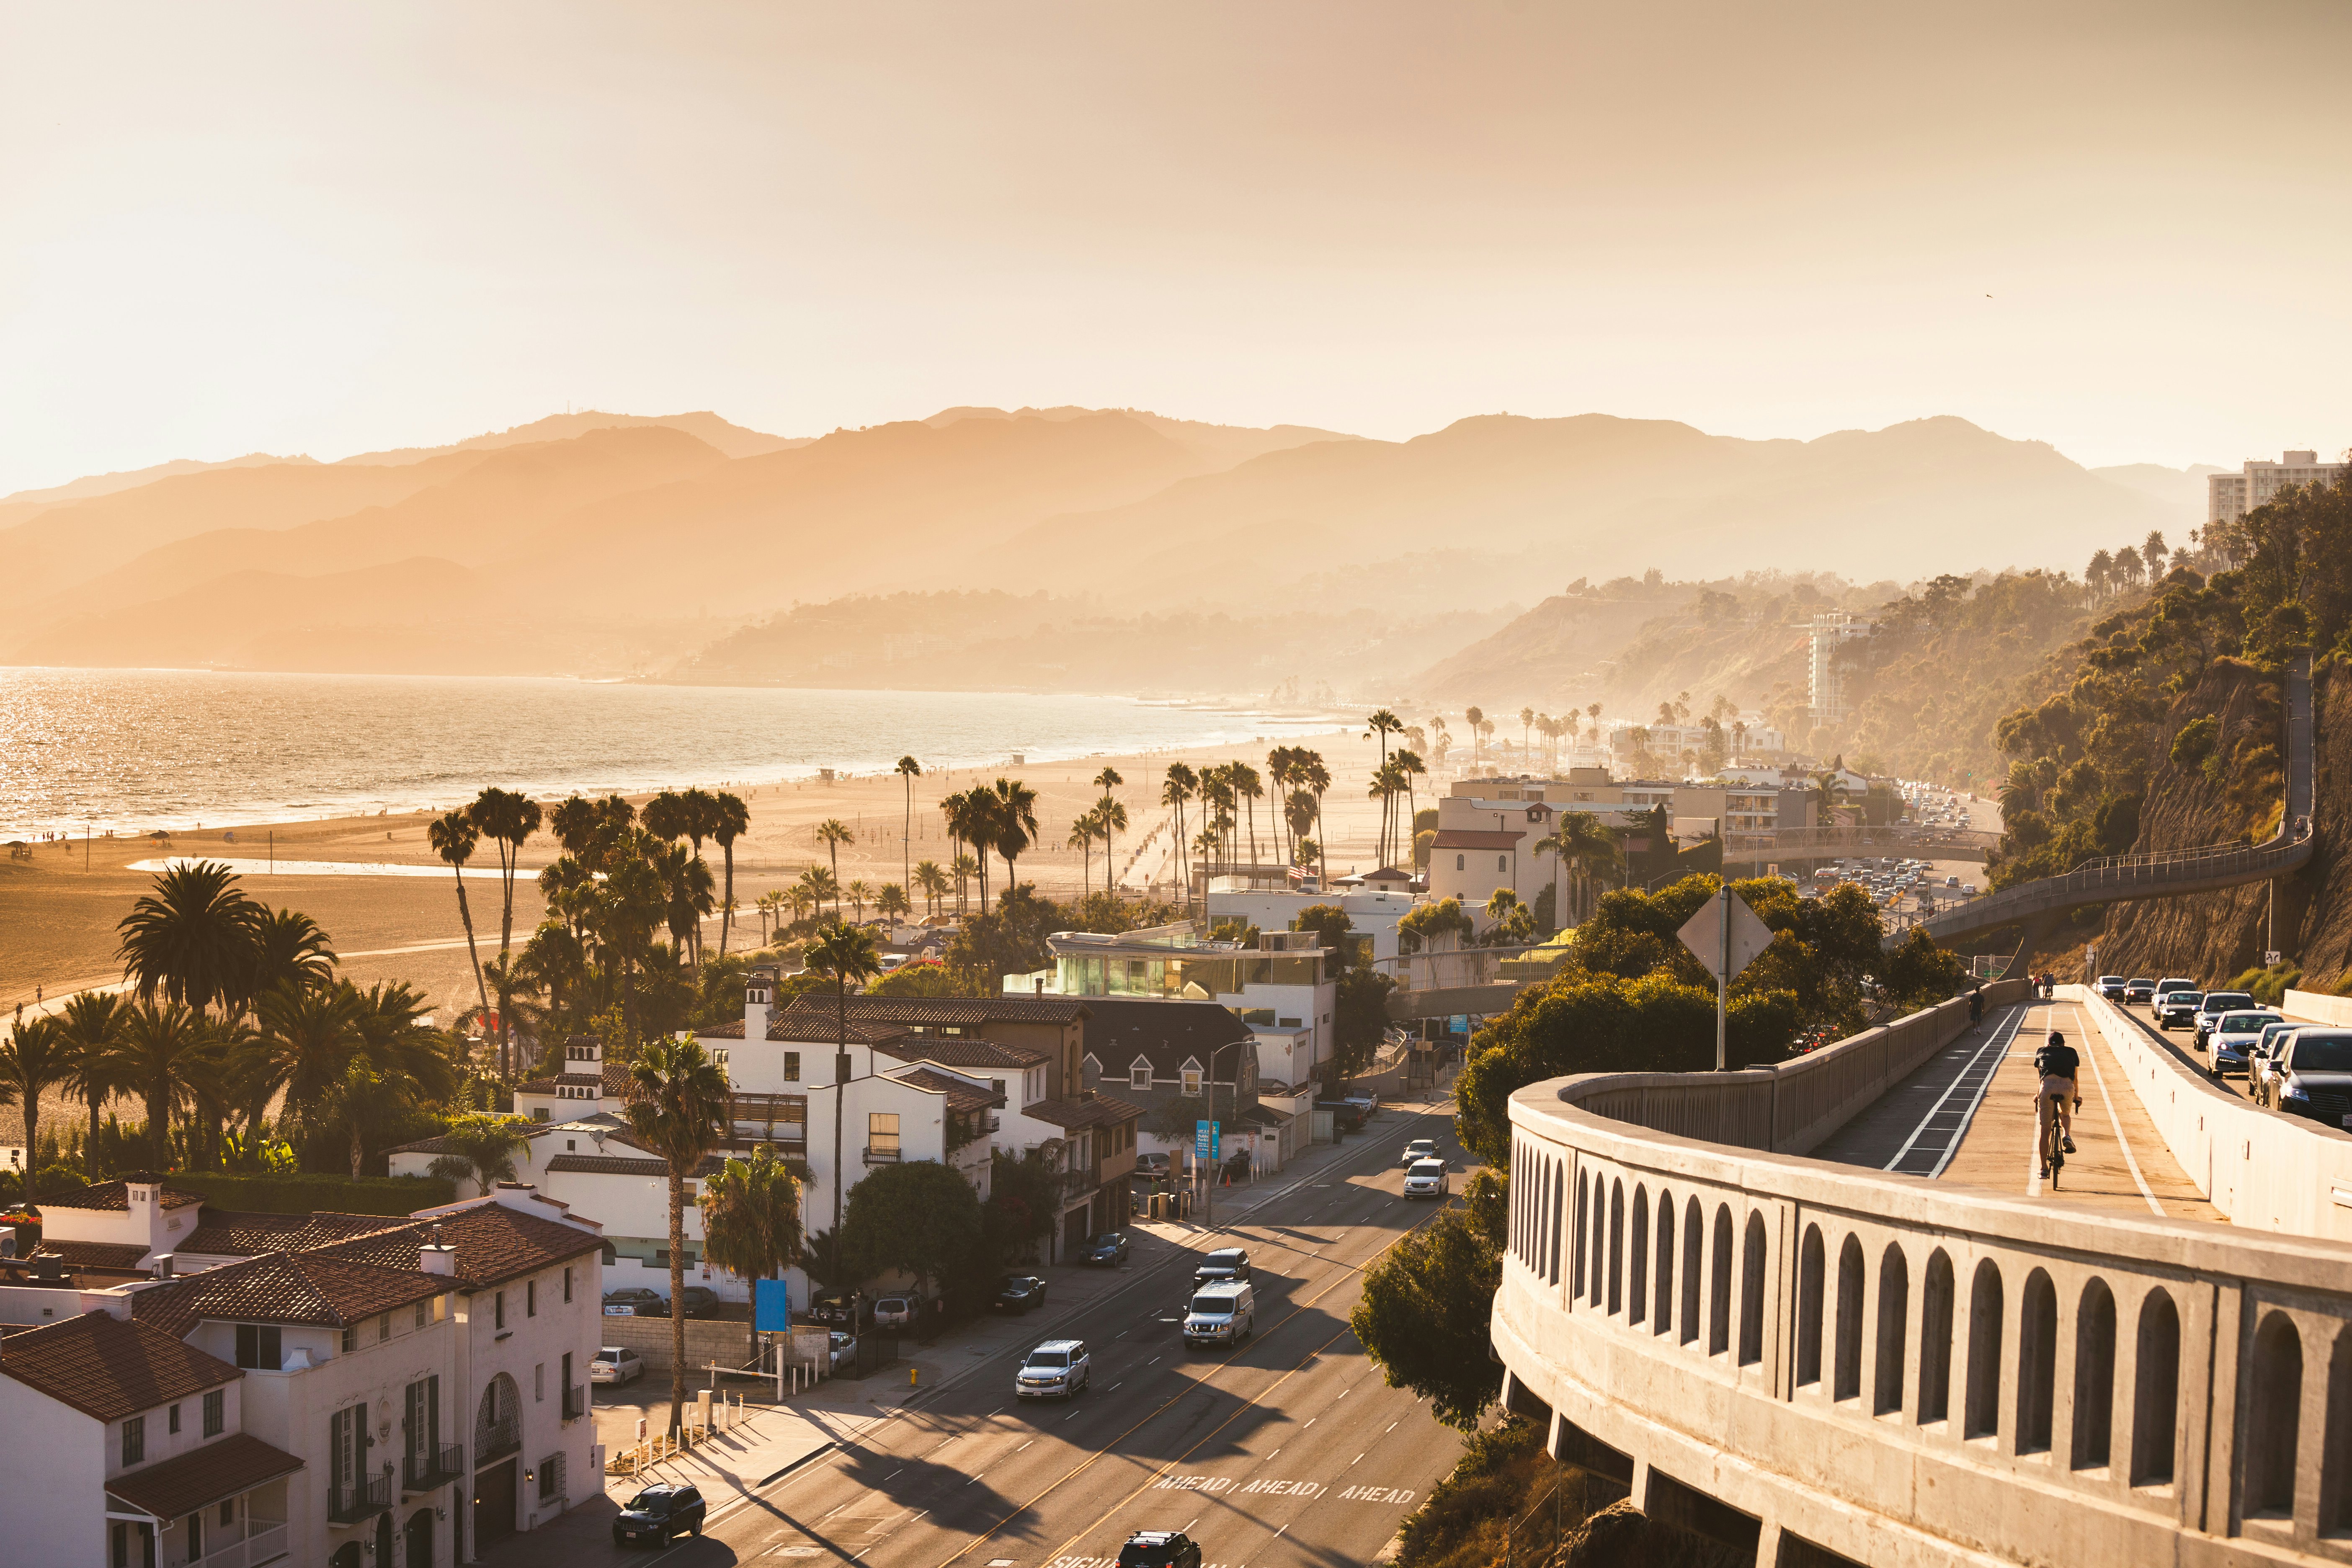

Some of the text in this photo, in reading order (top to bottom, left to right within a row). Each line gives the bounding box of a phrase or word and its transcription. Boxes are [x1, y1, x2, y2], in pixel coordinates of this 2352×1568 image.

[1152, 1475, 1231, 1491] AHEAD
[1240, 1479, 1319, 1495] AHEAD
[1337, 1485, 1416, 1504] AHEAD
